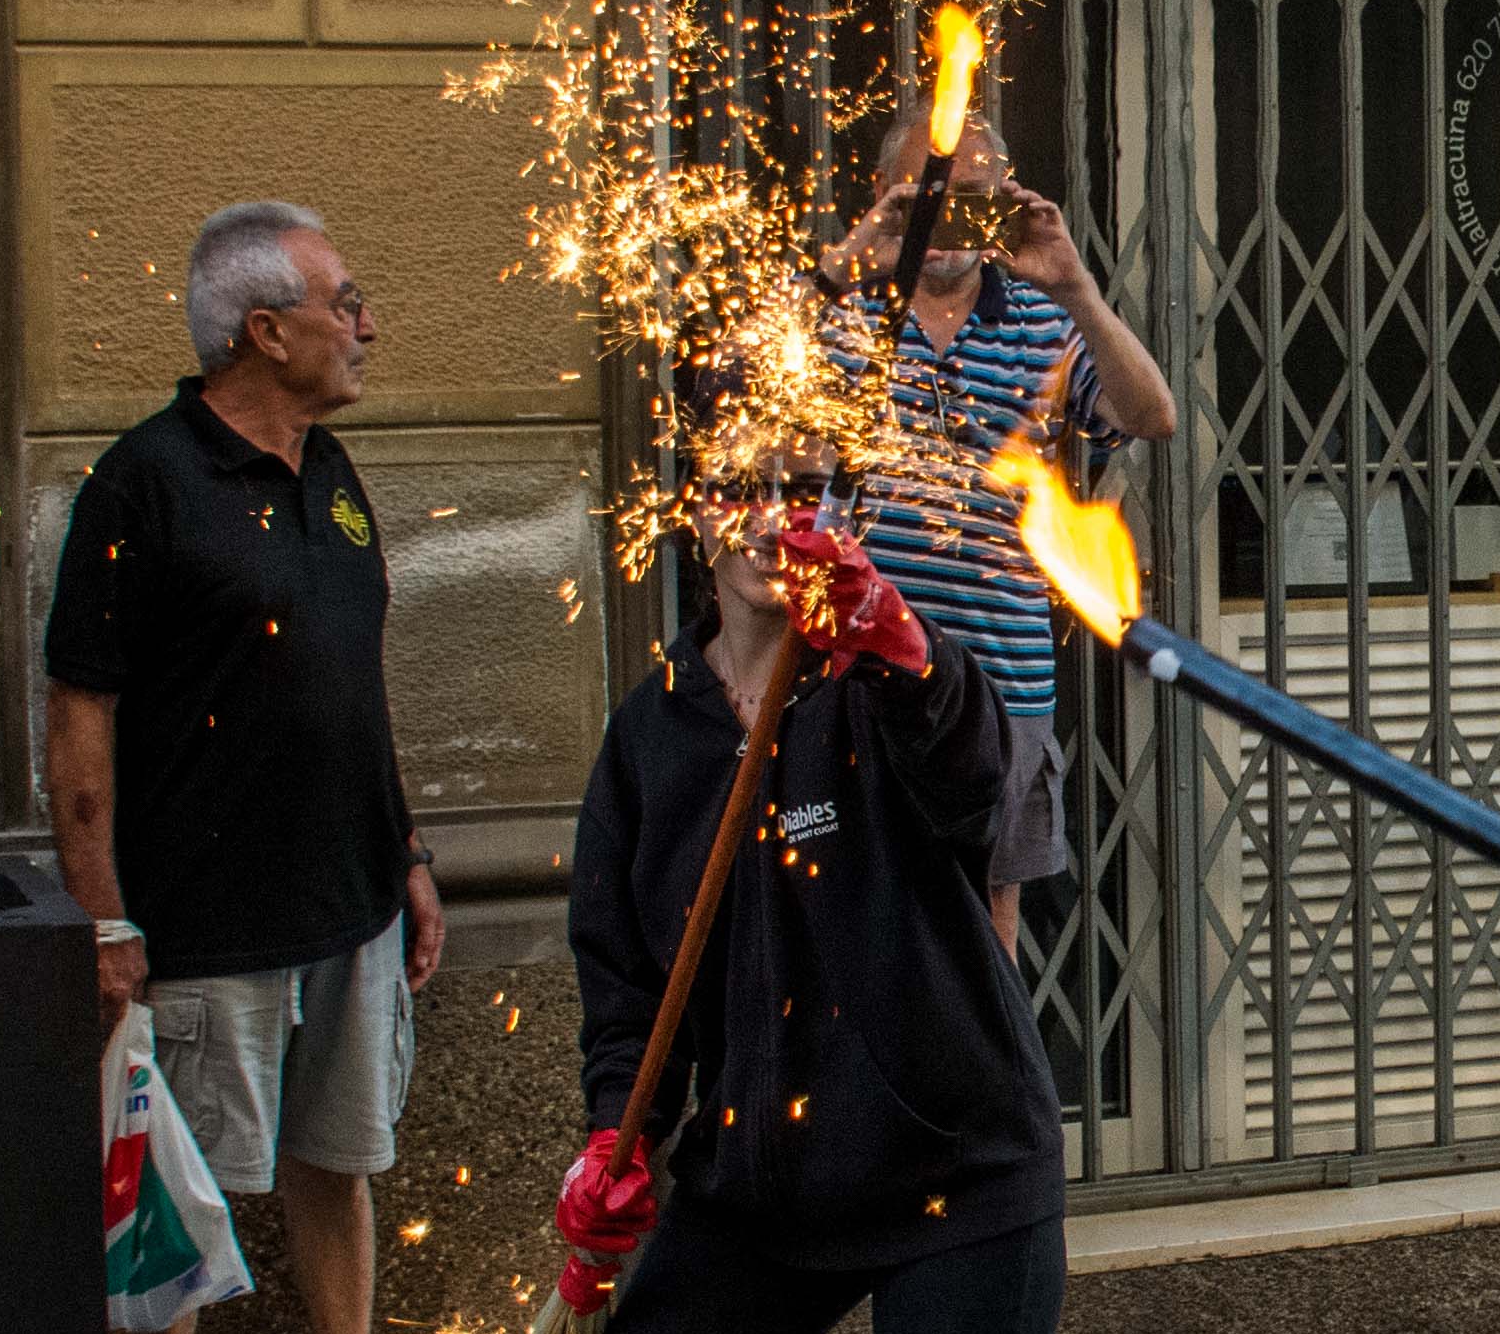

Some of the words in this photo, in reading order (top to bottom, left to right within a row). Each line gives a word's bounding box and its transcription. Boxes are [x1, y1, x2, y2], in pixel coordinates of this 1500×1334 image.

[1456, 38, 1493, 91] 620
[777, 800, 837, 834] Diables
[814, 821, 839, 836] CUGAT
